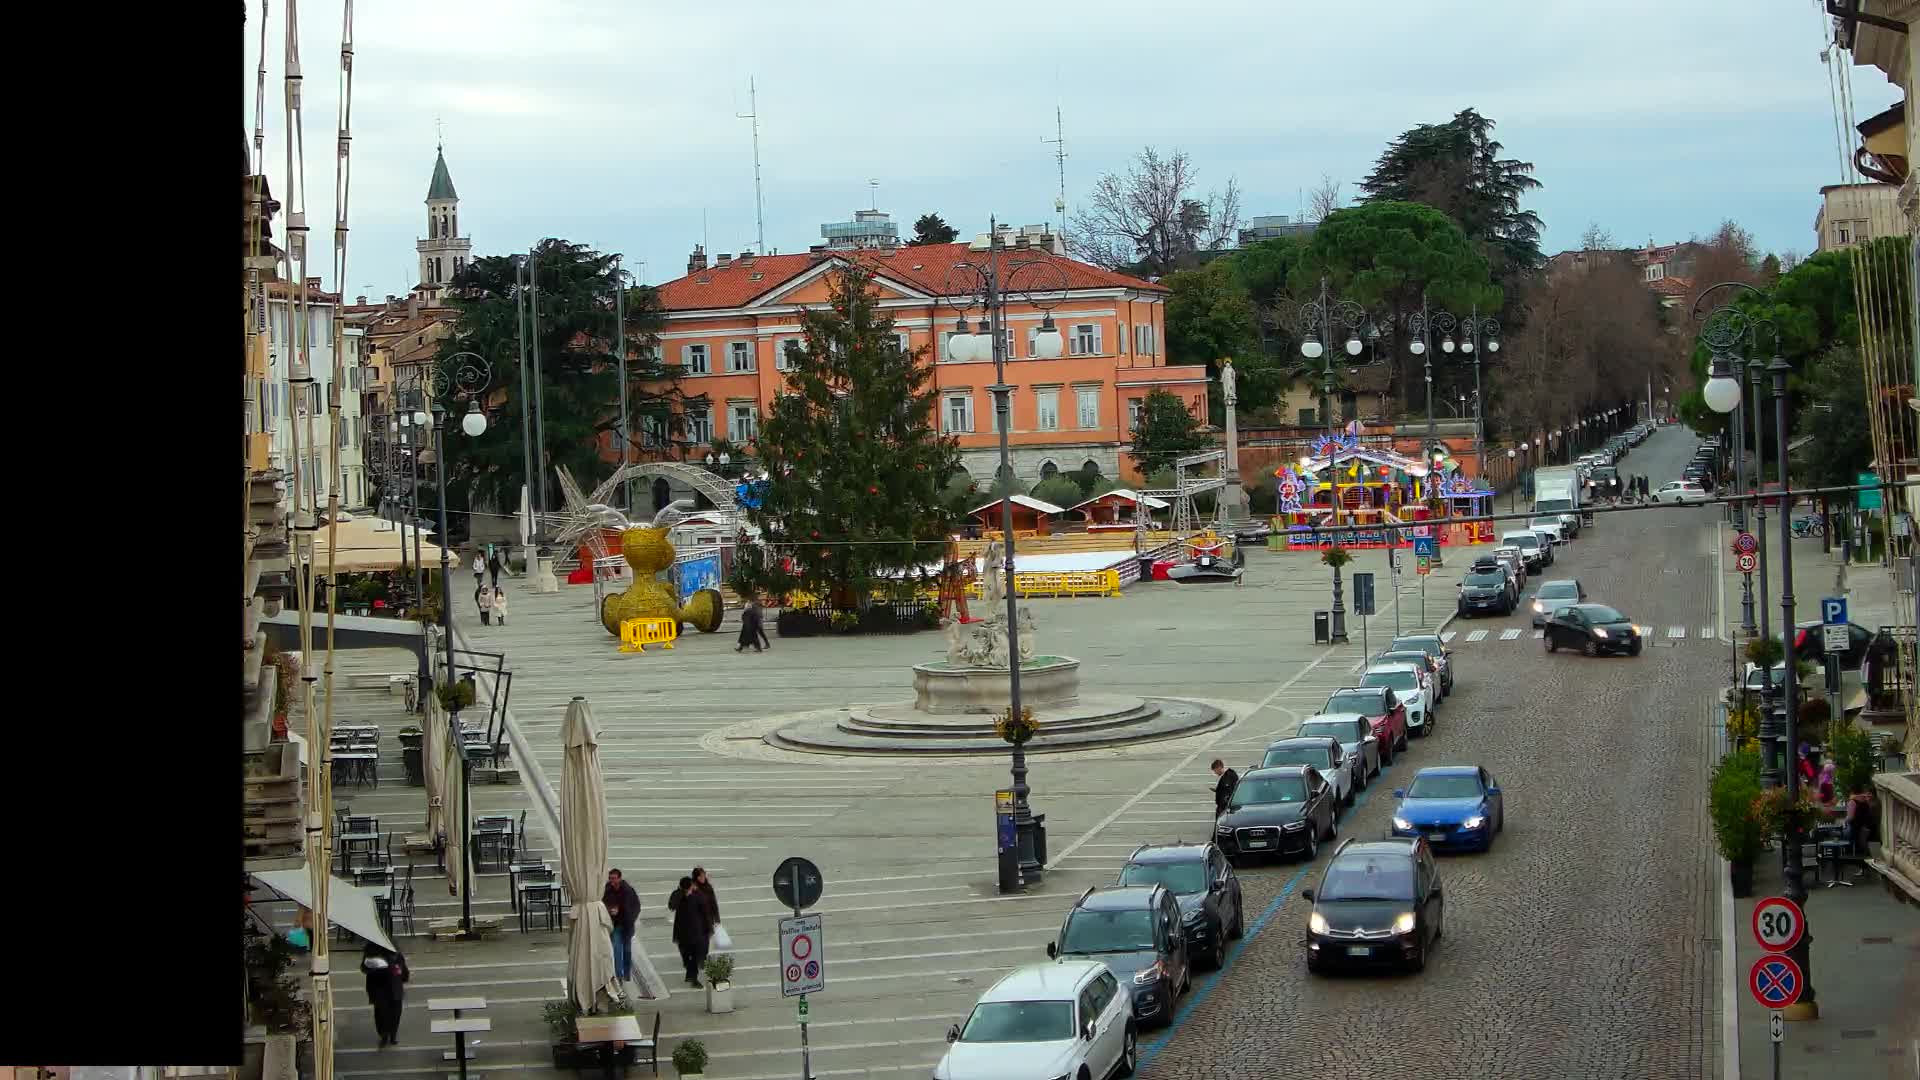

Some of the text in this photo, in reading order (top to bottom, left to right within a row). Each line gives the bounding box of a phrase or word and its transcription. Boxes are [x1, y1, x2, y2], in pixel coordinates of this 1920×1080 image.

[1742, 557, 1753, 567] 20
[1827, 602, 1842, 622] P
[1761, 911, 1792, 938] 30
